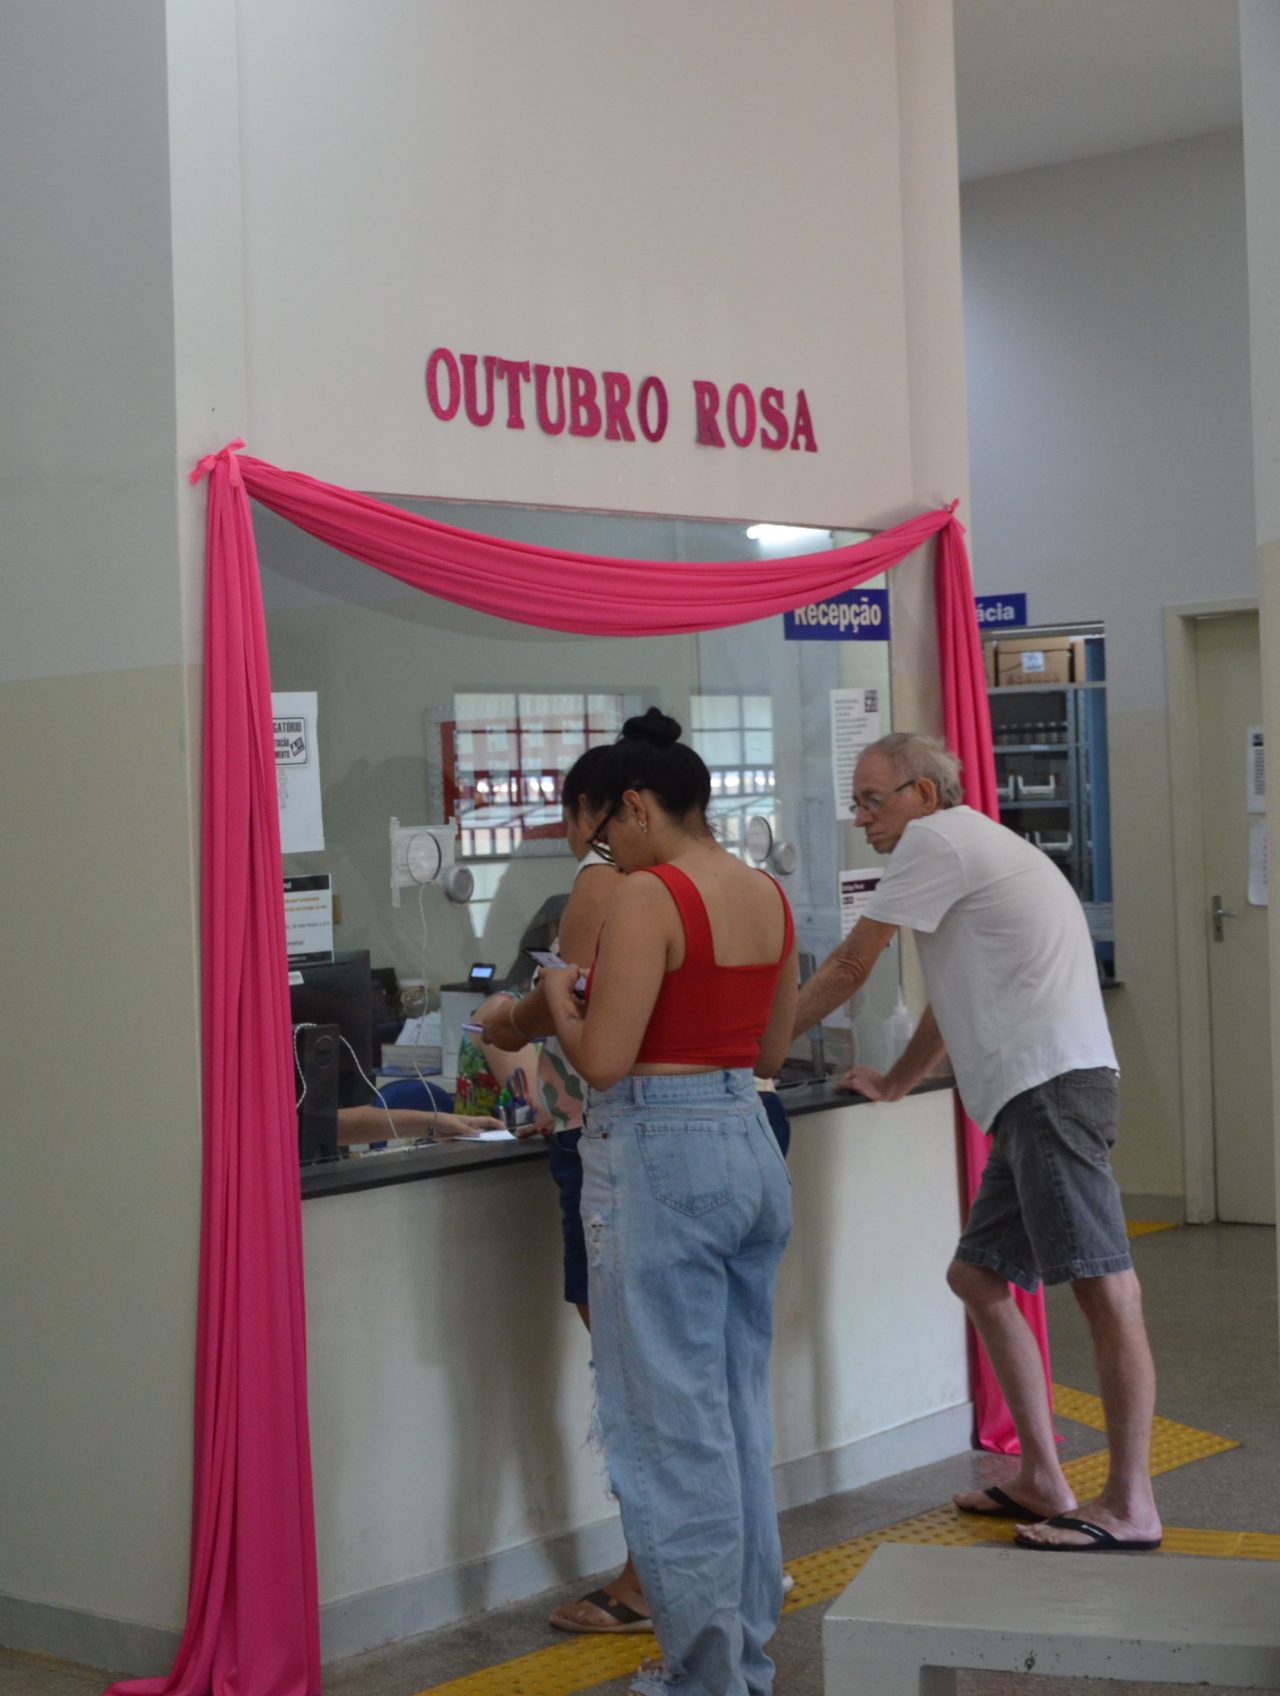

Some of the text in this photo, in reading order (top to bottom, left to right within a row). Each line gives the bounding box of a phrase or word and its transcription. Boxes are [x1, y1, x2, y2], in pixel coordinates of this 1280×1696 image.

[426, 347, 817, 452] OUTUBRO ROSA
[794, 597, 881, 633] Recepção
[975, 603, 1015, 622] ácia
